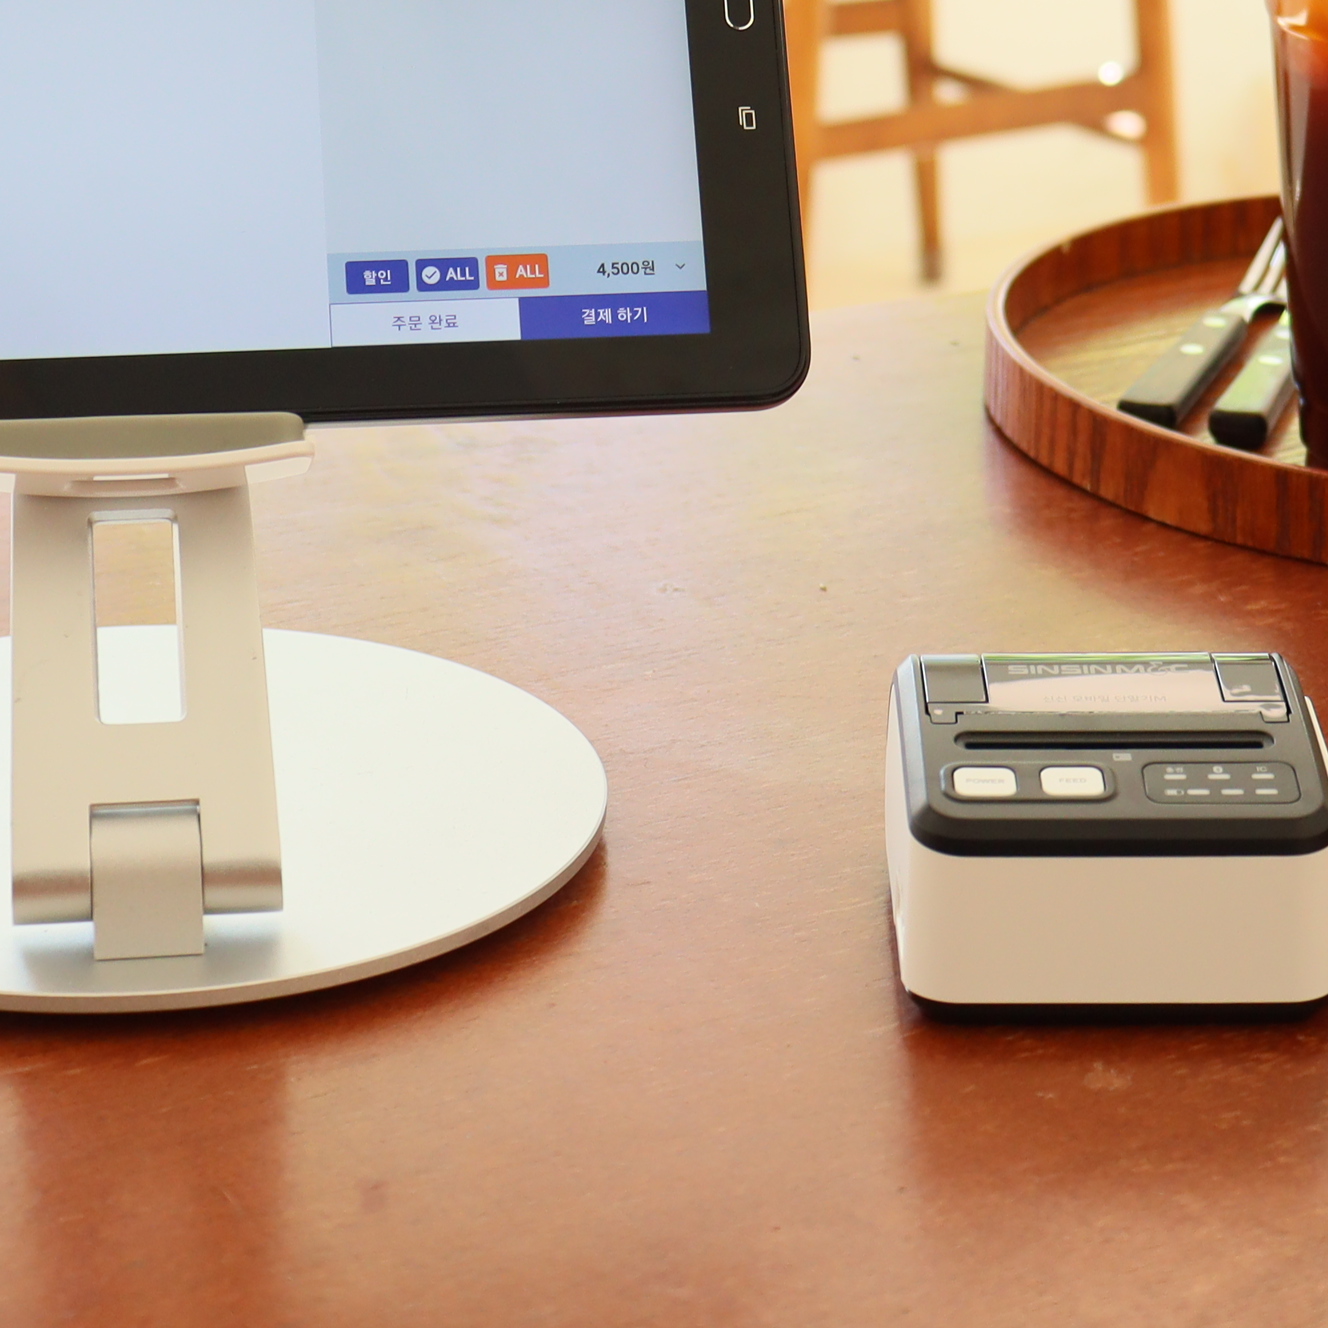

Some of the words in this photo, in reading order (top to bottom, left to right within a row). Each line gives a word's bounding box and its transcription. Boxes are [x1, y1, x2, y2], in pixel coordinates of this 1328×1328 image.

[363, 268, 392, 286] 할인
[445, 266, 475, 282] ALL
[515, 264, 544, 279] ALL
[596, 259, 656, 279] 4,500원
[391, 314, 423, 331] 주문
[428, 313, 460, 330] 완료
[581, 307, 613, 325] 결제
[616, 305, 648, 323] 하기
